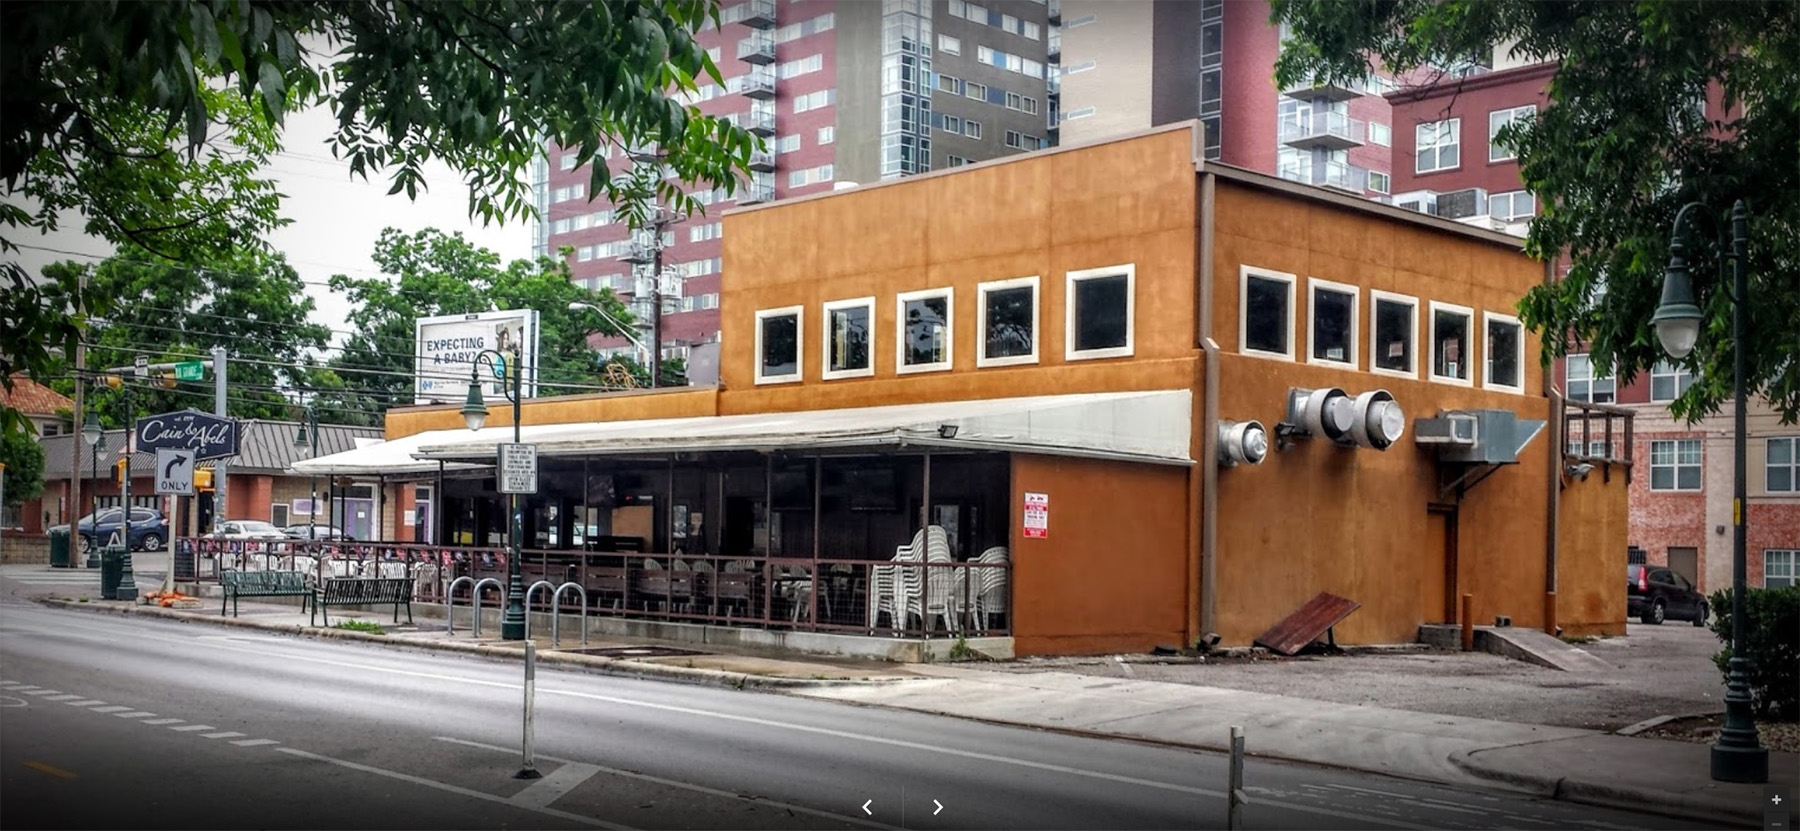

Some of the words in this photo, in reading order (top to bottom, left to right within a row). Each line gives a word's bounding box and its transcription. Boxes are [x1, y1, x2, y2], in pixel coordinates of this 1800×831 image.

[427, 337, 484, 351] EXPECTING
[434, 353, 441, 364] A
[142, 420, 185, 442] Cain
[185, 422, 198, 435] &
[187, 423, 229, 447] Abels
[161, 481, 188, 490] ONLY
